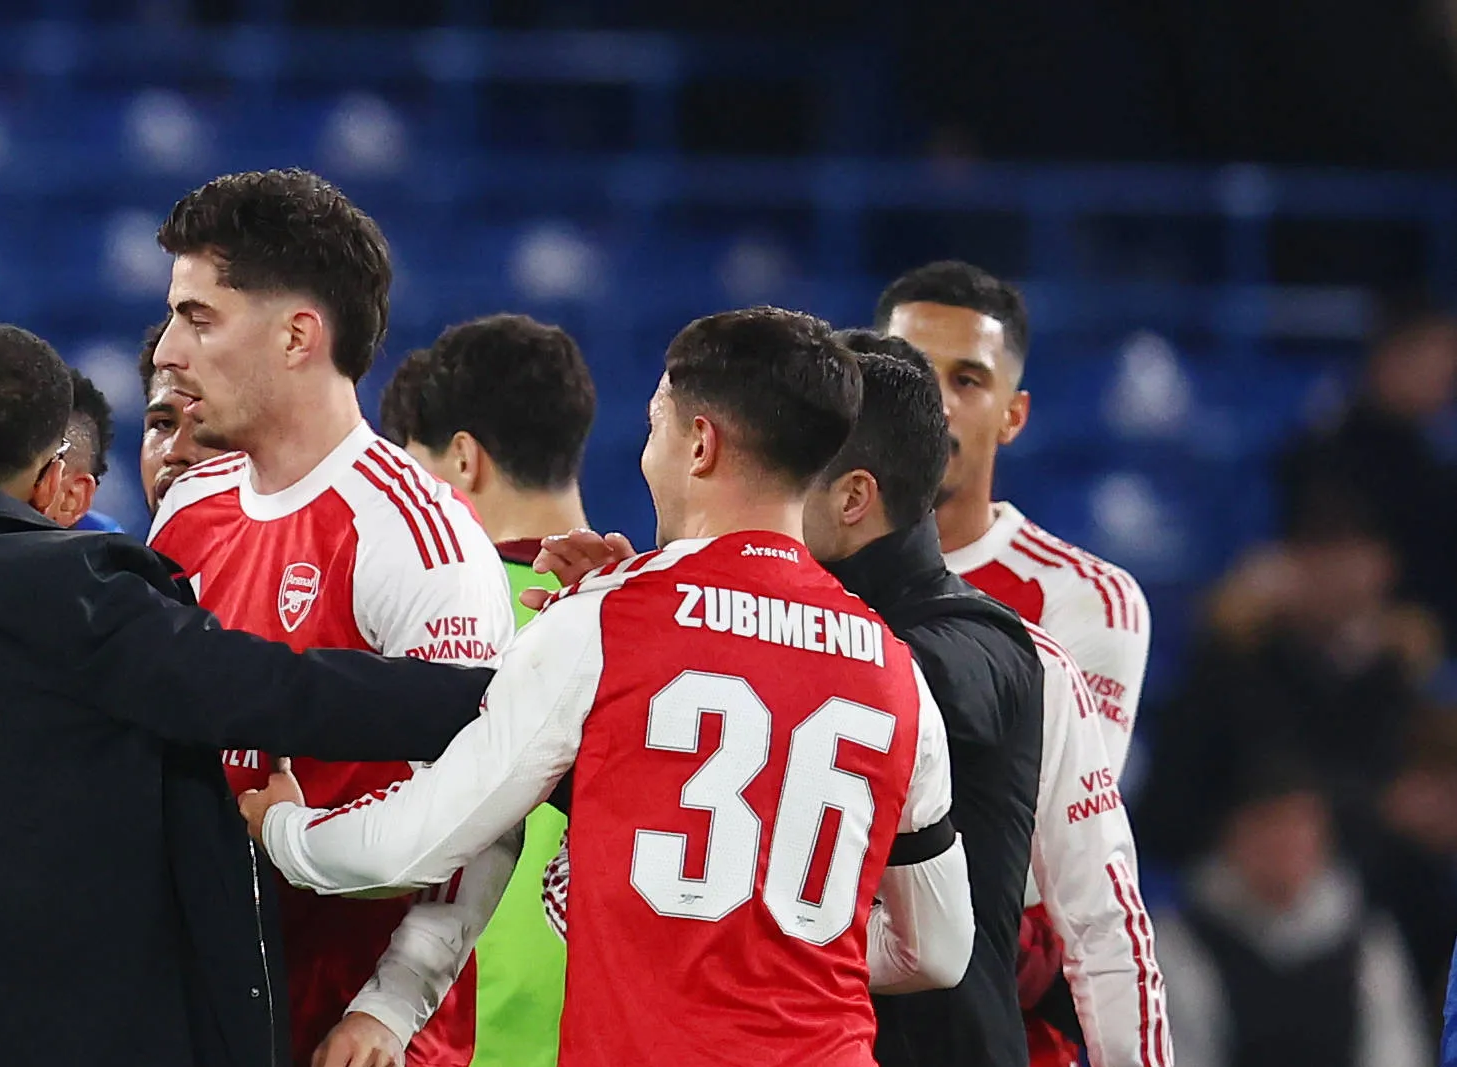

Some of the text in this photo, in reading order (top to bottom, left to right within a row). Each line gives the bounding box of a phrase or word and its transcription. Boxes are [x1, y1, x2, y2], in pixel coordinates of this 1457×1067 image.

[741, 543, 799, 563] Arsenal
[425, 616, 478, 639] VISIT
[673, 583, 885, 668] ZUBIMENDI
[1080, 768, 1113, 792] VIS
[630, 669, 896, 946] 36
[1067, 790, 1123, 824] RWAN
